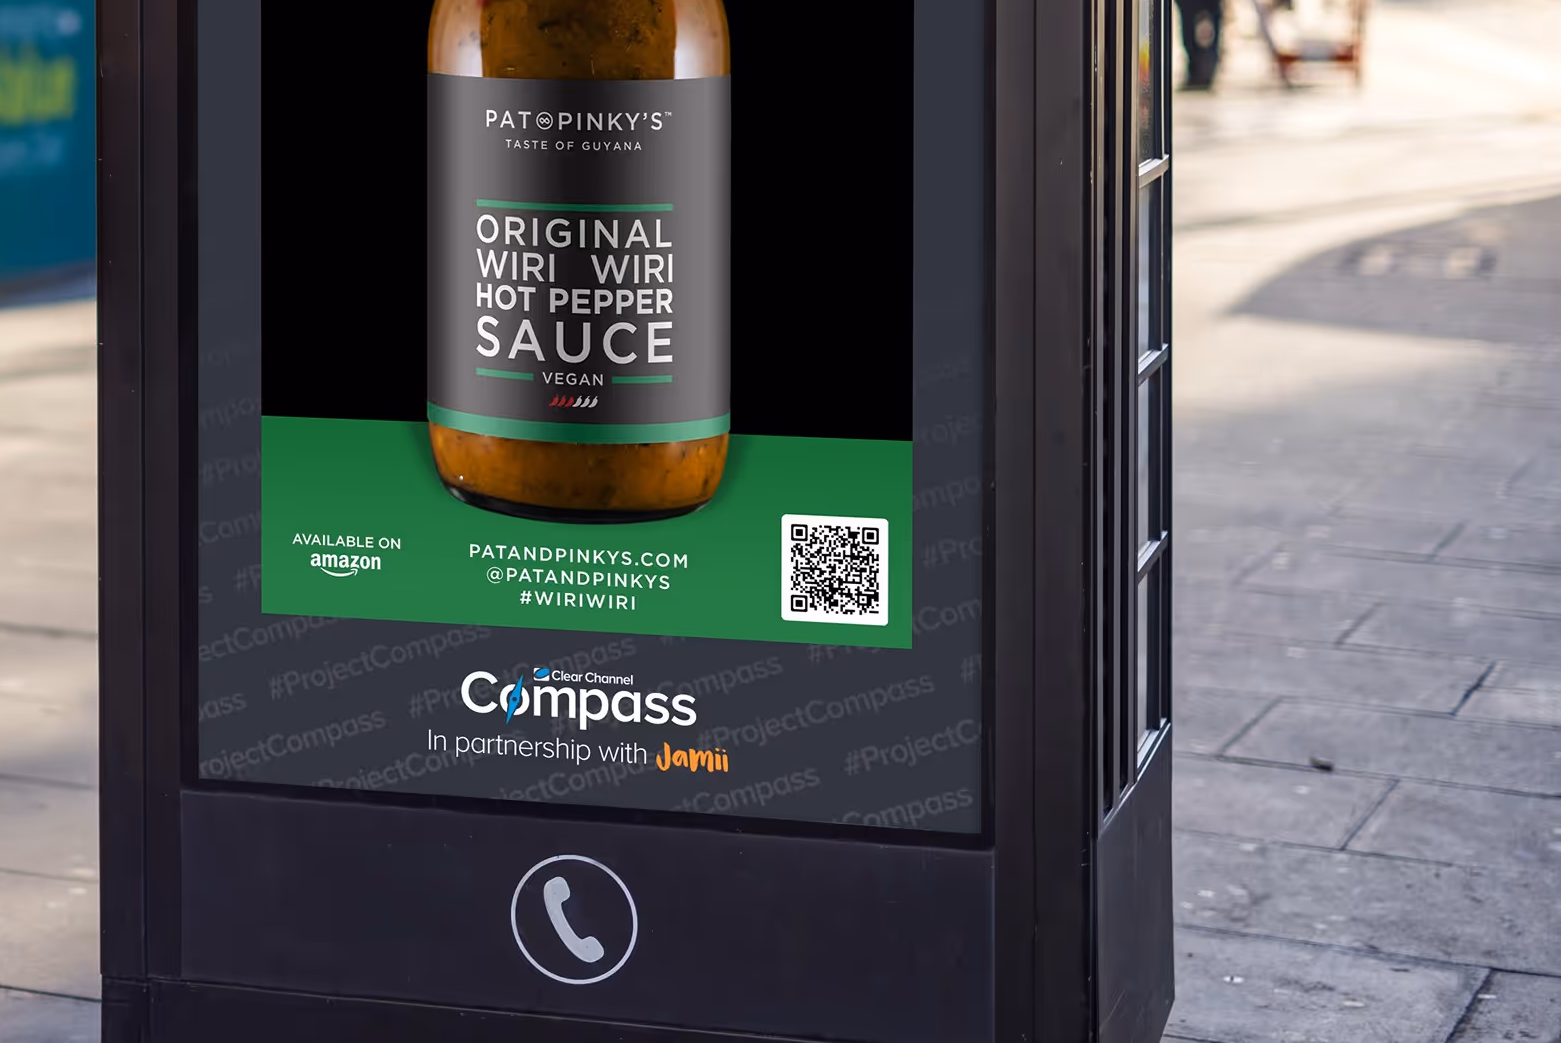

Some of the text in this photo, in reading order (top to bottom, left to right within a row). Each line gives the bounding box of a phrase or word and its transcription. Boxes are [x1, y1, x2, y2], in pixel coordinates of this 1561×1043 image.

[485, 109, 532, 130] PAT
[505, 138, 642, 151] TASTE OF GUYANA
[476, 213, 672, 249] ORIGINAL
[476, 248, 674, 284] WIRI WIRI
[476, 282, 674, 315] HOT PEPPER
[475, 315, 674, 365] SAUCE
[542, 371, 604, 386] VEGAN
[292, 533, 402, 550] AVAILABLE ON
[310, 552, 382, 572] amazon
[469, 543, 688, 569] PATANDPINKYS.COM
[486, 566, 671, 590] @PATANDPINKYS
[519, 590, 637, 611] #WIRIWIRI
[268, 624, 492, 701] #ProjectCompass
[551, 669, 634, 686] Clear Channel
[460, 670, 698, 731] Compass
[428, 729, 730, 774] In partnership with Jamii
